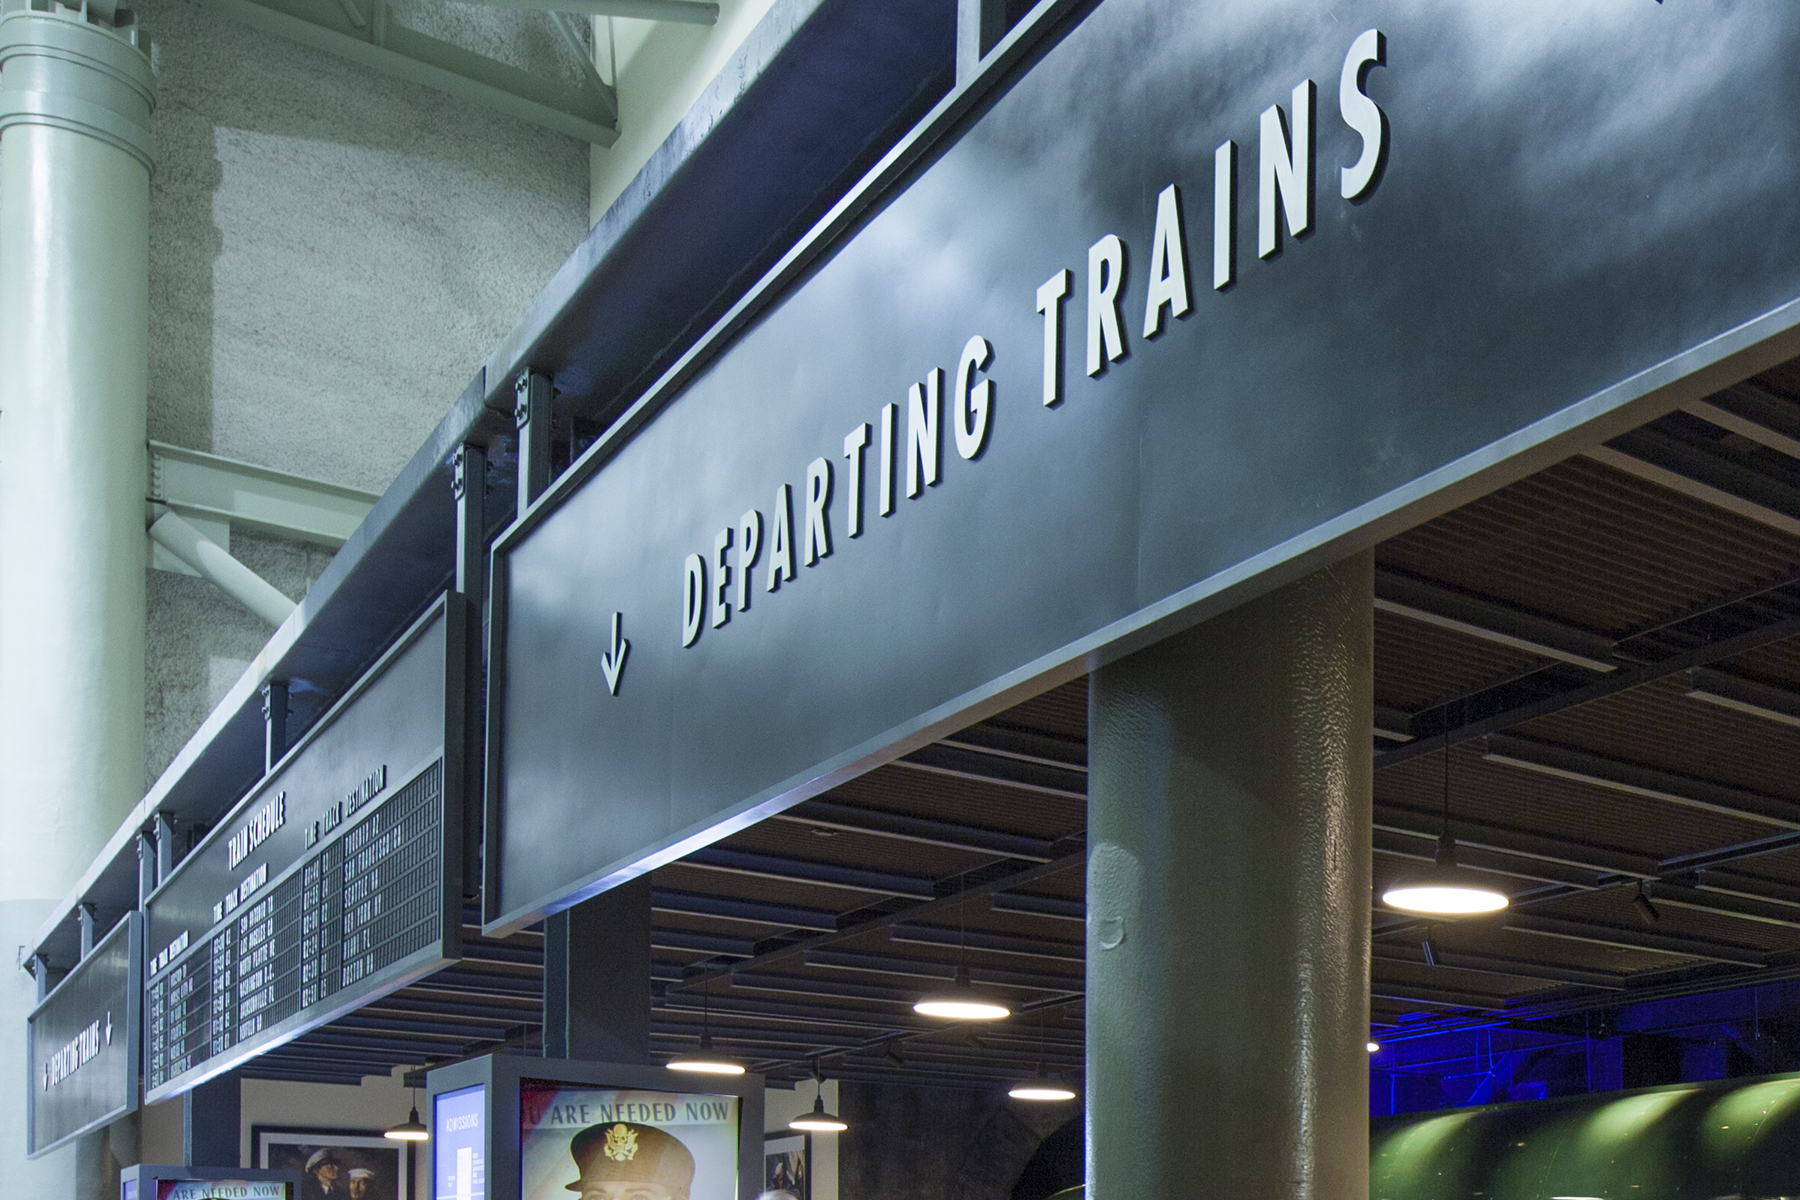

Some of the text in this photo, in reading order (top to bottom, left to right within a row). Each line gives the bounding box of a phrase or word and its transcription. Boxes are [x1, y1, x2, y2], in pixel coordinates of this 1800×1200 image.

[681, 28, 1388, 648] DEPARTING TRAINS
[305, 764, 387, 850] TIME TRACK DESTINATION
[228, 790, 286, 871] TRAIN SCHEDULE
[344, 859, 355, 883] SAN
[358, 833, 390, 874] FRANCISCO
[240, 862, 268, 903] DESTINATION
[344, 876, 368, 910] SEATTLE
[344, 911, 354, 935] NEW
[357, 900, 371, 926] YORK
[240, 936, 248, 956] LOS
[248, 922, 266, 951] ANGELES
[343, 933, 360, 962] MIAMI
[363, 928, 371, 951] FL
[240, 969, 263, 998] WASHINGTON
[342, 958, 363, 988] BOSTON
[51, 1036, 79, 1087] DEPARTING
[79, 1019, 100, 1066] TRAINS
[446, 1113, 479, 1132] ADMISSIONS
[551, 1104, 591, 1125] ARE
[600, 1102, 676, 1123] NEEDED
[686, 1101, 729, 1121] NOW
[173, 1185, 281, 1200] ARE NEEDED NOW
